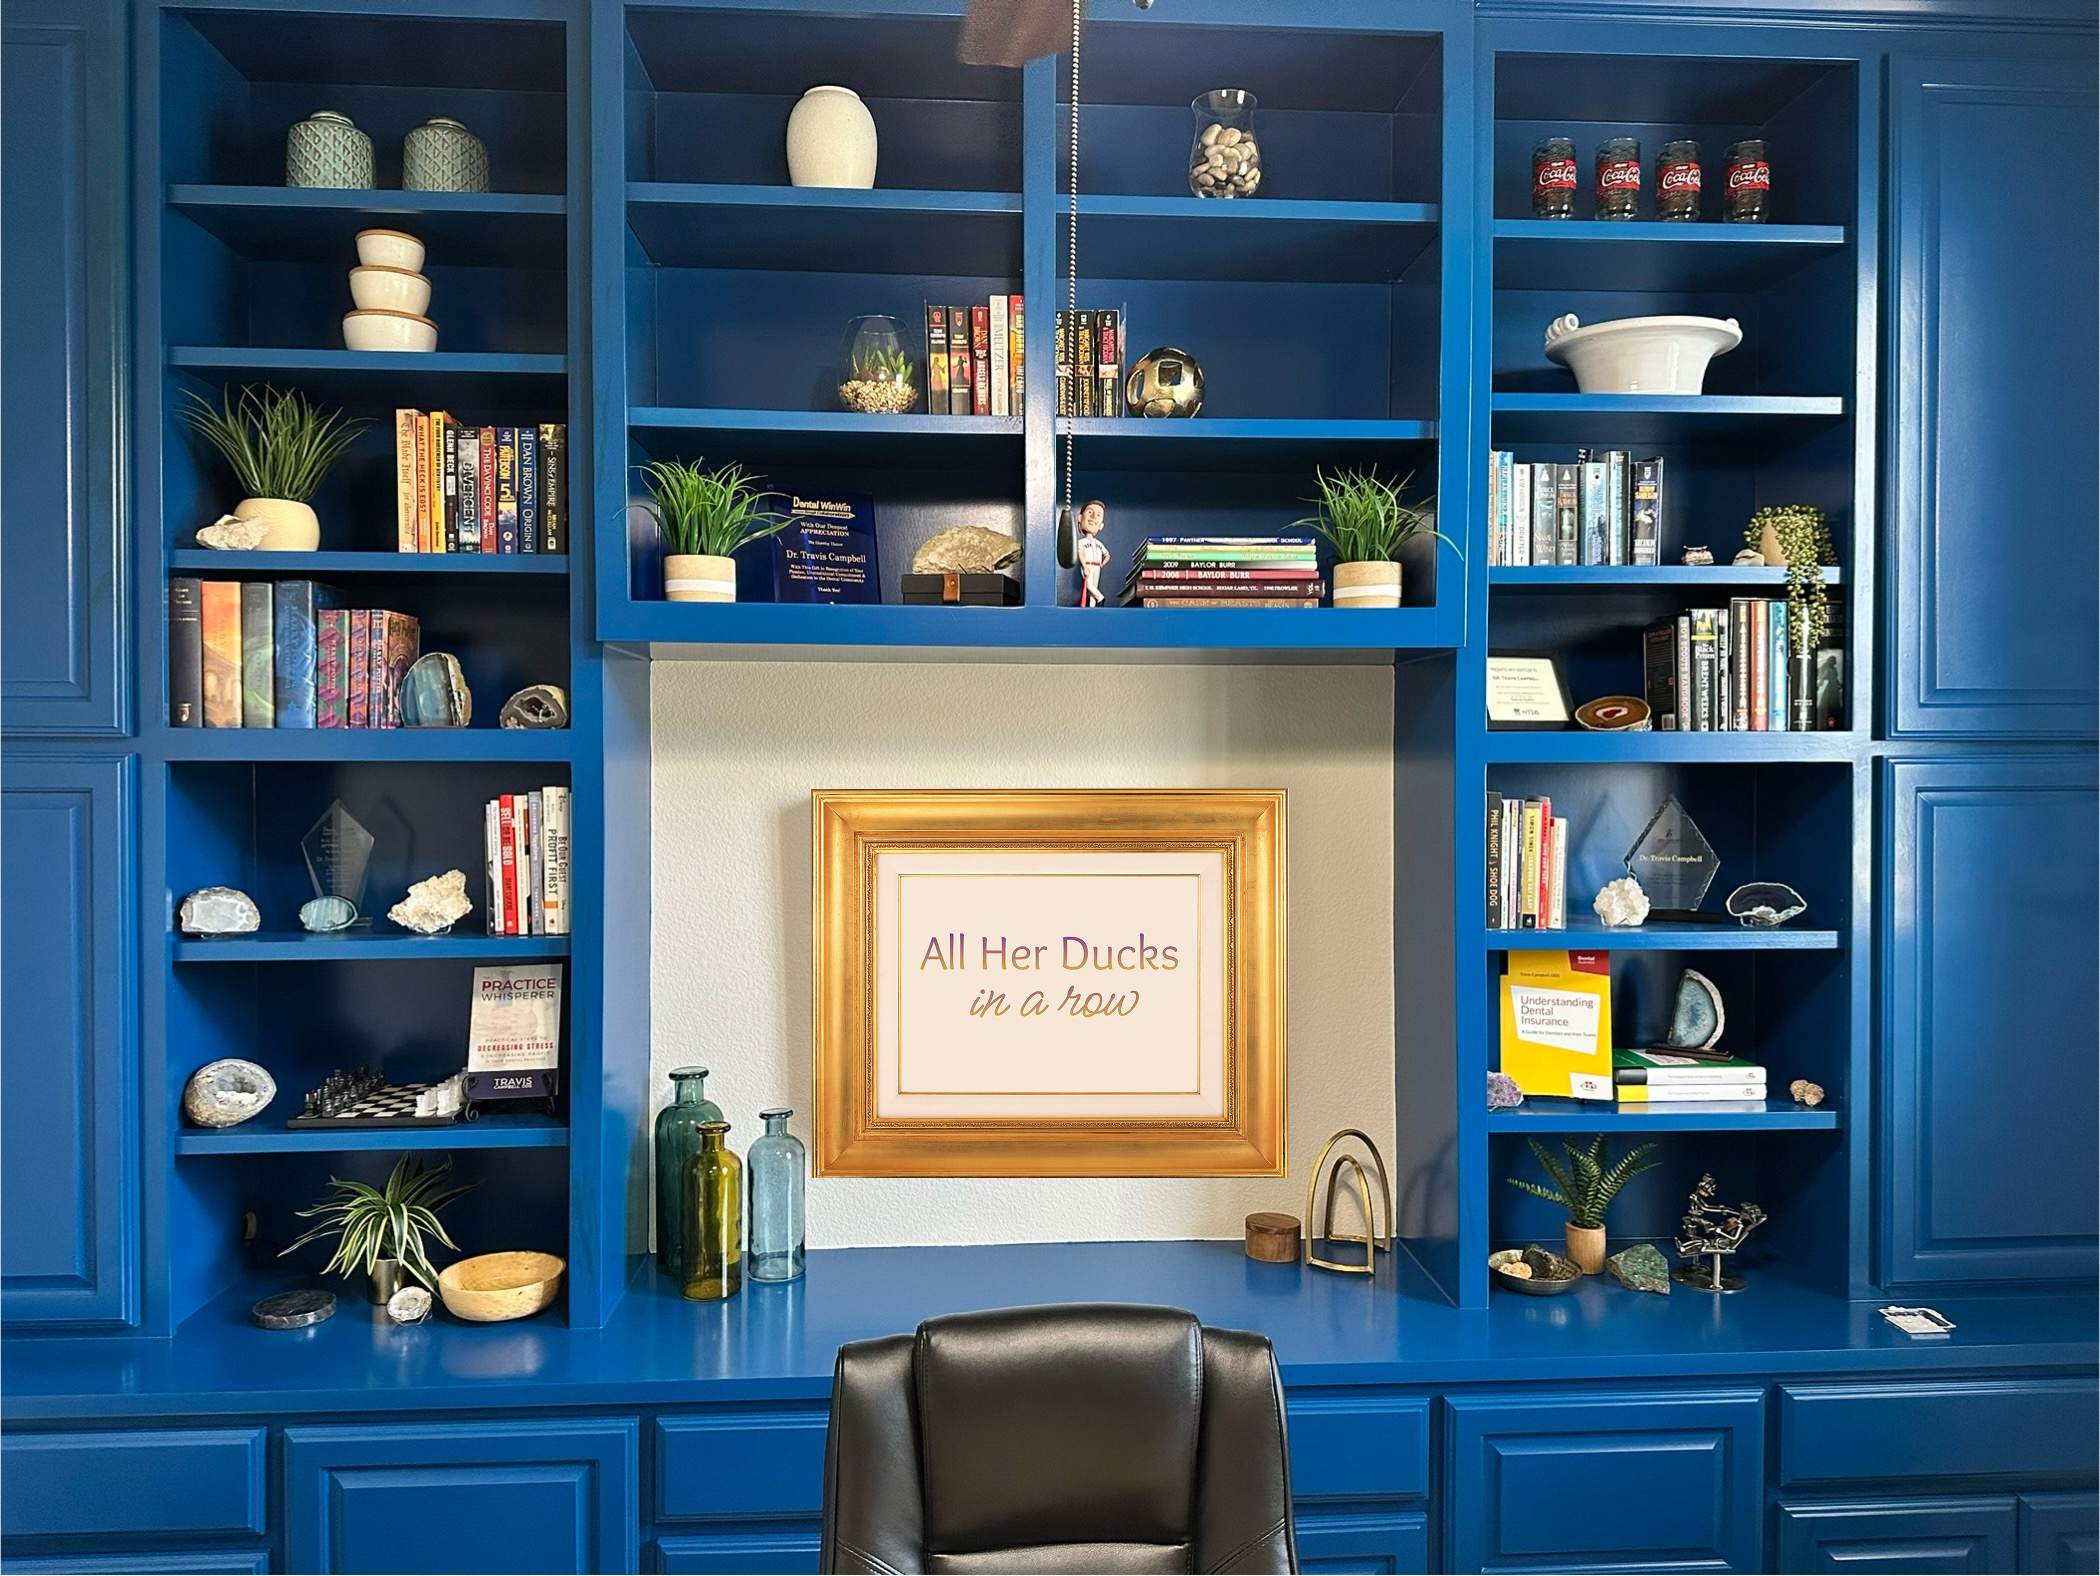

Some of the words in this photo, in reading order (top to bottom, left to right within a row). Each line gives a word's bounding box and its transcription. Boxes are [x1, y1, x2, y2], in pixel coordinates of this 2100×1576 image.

[973, 326, 982, 348] BROWN
[994, 328, 1004, 371] MELTZER
[977, 360, 986, 381] ANGELS
[399, 422, 411, 438] The
[401, 440, 411, 461] Blade
[446, 430, 456, 452] GLENN
[499, 446, 510, 479] PATTERSON
[523, 442, 532, 465] DAN
[447, 455, 456, 473] BECK
[548, 457, 557, 473] SINS
[400, 464, 411, 486] Itself
[484, 474, 492, 495] VINCI
[419, 485, 425, 493] IS
[500, 483, 511, 498] 5
[523, 467, 532, 504] BROWN
[546, 478, 556, 507] EMPIRE
[462, 461, 475, 533] DIVERGENT
[484, 496, 492, 516] CODE
[793, 496, 819, 509] Dental
[820, 501, 851, 512] WinWin
[522, 509, 534, 542] ORIGIN
[800, 528, 849, 537] APPRECIATION
[786, 550, 799, 559] Dr.
[800, 551, 827, 560] Travis
[828, 553, 866, 564] Campbell
[1536, 544, 1555, 553] WIND
[1198, 571, 1226, 579] BAYLOR
[1701, 661, 1709, 688] BRENT
[1701, 689, 1709, 718] WEEKS
[501, 807, 511, 825] SELL
[1490, 809, 1498, 827] PHIL
[502, 827, 510, 835] OR
[503, 836, 510, 845] BE
[558, 836, 567, 845] BE
[531, 834, 539, 861] Happiness
[548, 829, 557, 864] PROFIT
[1490, 829, 1498, 858] KNIGHT
[503, 846, 513, 866] SOLD
[558, 847, 568, 860] OUR
[1672, 855, 1703, 863] Campbell
[548, 867, 557, 895] FIRST
[558, 862, 567, 882] GUEST
[1490, 867, 1498, 888] SHOE
[1490, 889, 1498, 906] DOG
[920, 932, 965, 971] All
[982, 936, 1048, 971] Her
[1062, 932, 1179, 971] Ducks
[482, 978, 556, 991] PRACTICE
[481, 990, 554, 1001] WHISPERER
[969, 988, 1011, 1018] in
[1020, 990, 1049, 1017] a
[1057, 985, 1140, 1018] row
[1520, 996, 1594, 1009] Understanding
[1521, 1006, 1553, 1015] Dental
[1521, 1016, 1569, 1026] Insurance
[477, 1044, 523, 1052] DECREASING
[494, 1077, 532, 1085] TRAVIS
